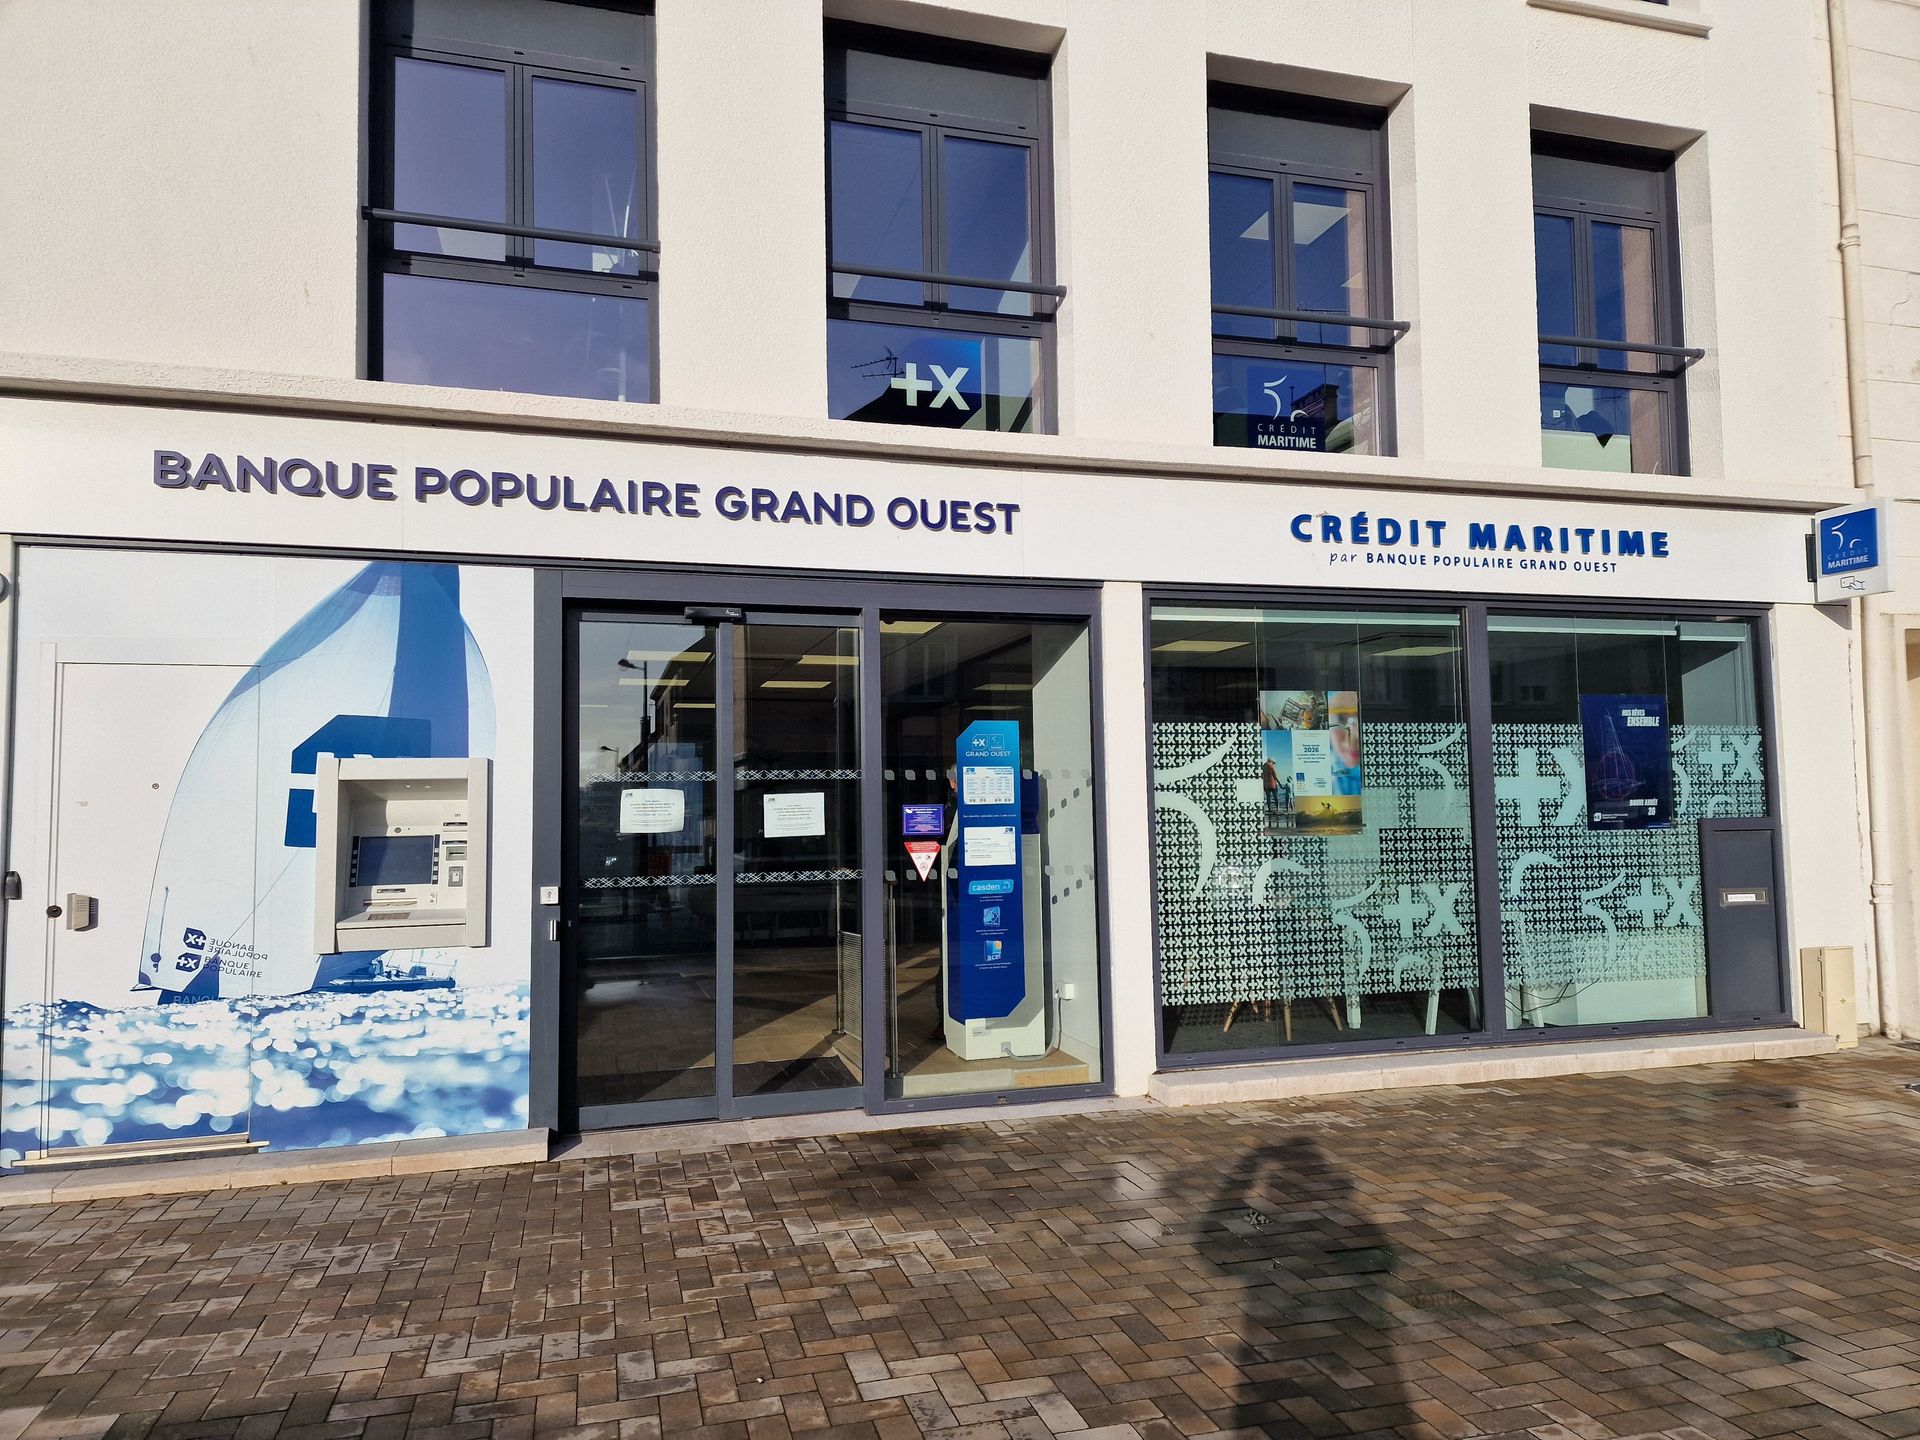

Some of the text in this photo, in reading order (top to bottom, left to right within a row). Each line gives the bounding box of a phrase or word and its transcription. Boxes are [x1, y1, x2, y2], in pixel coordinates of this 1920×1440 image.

[1257, 423, 1317, 435] CRÉDIT
[1257, 434, 1317, 449] MARITIME
[153, 449, 1021, 535] BANQUE POPULAIRE GRAND OUEST
[1290, 511, 1670, 558] CRÉDIT MARITIME
[1329, 551, 1617, 573] par BANQUE POPULAIRE GRAND OUEST
[1827, 554, 1869, 569] MARITIME
[1627, 716, 1660, 727] ENSEMBLE
[965, 750, 989, 758] GRAND
[972, 883, 1001, 891] casden
[203, 963, 263, 978] POPULAIRE
[204, 956, 250, 970] BANQUE
